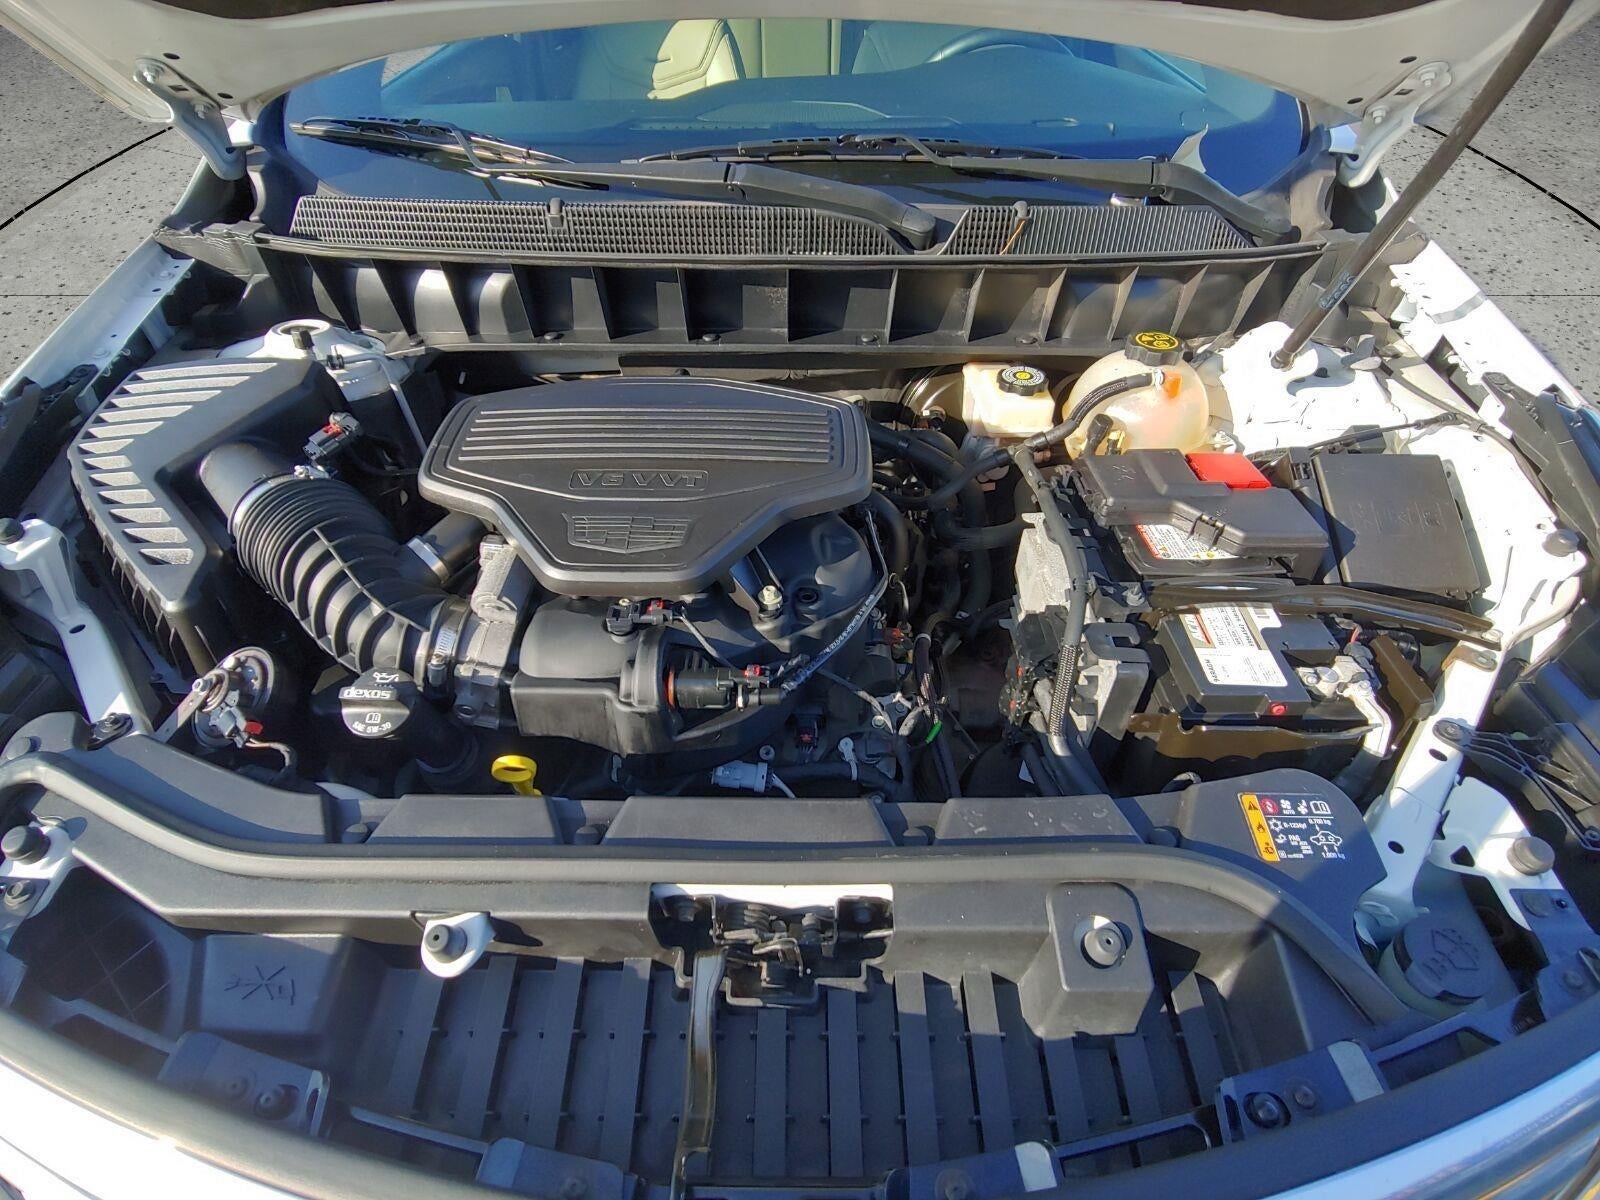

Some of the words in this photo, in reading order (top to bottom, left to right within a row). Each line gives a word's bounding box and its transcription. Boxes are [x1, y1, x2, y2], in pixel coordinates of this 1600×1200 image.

[577, 472, 625, 487] V6
[632, 471, 703, 487] VVT
[343, 687, 392, 699] dexos
[353, 721, 365, 732] SAE
[366, 721, 392, 733] 5W-30
